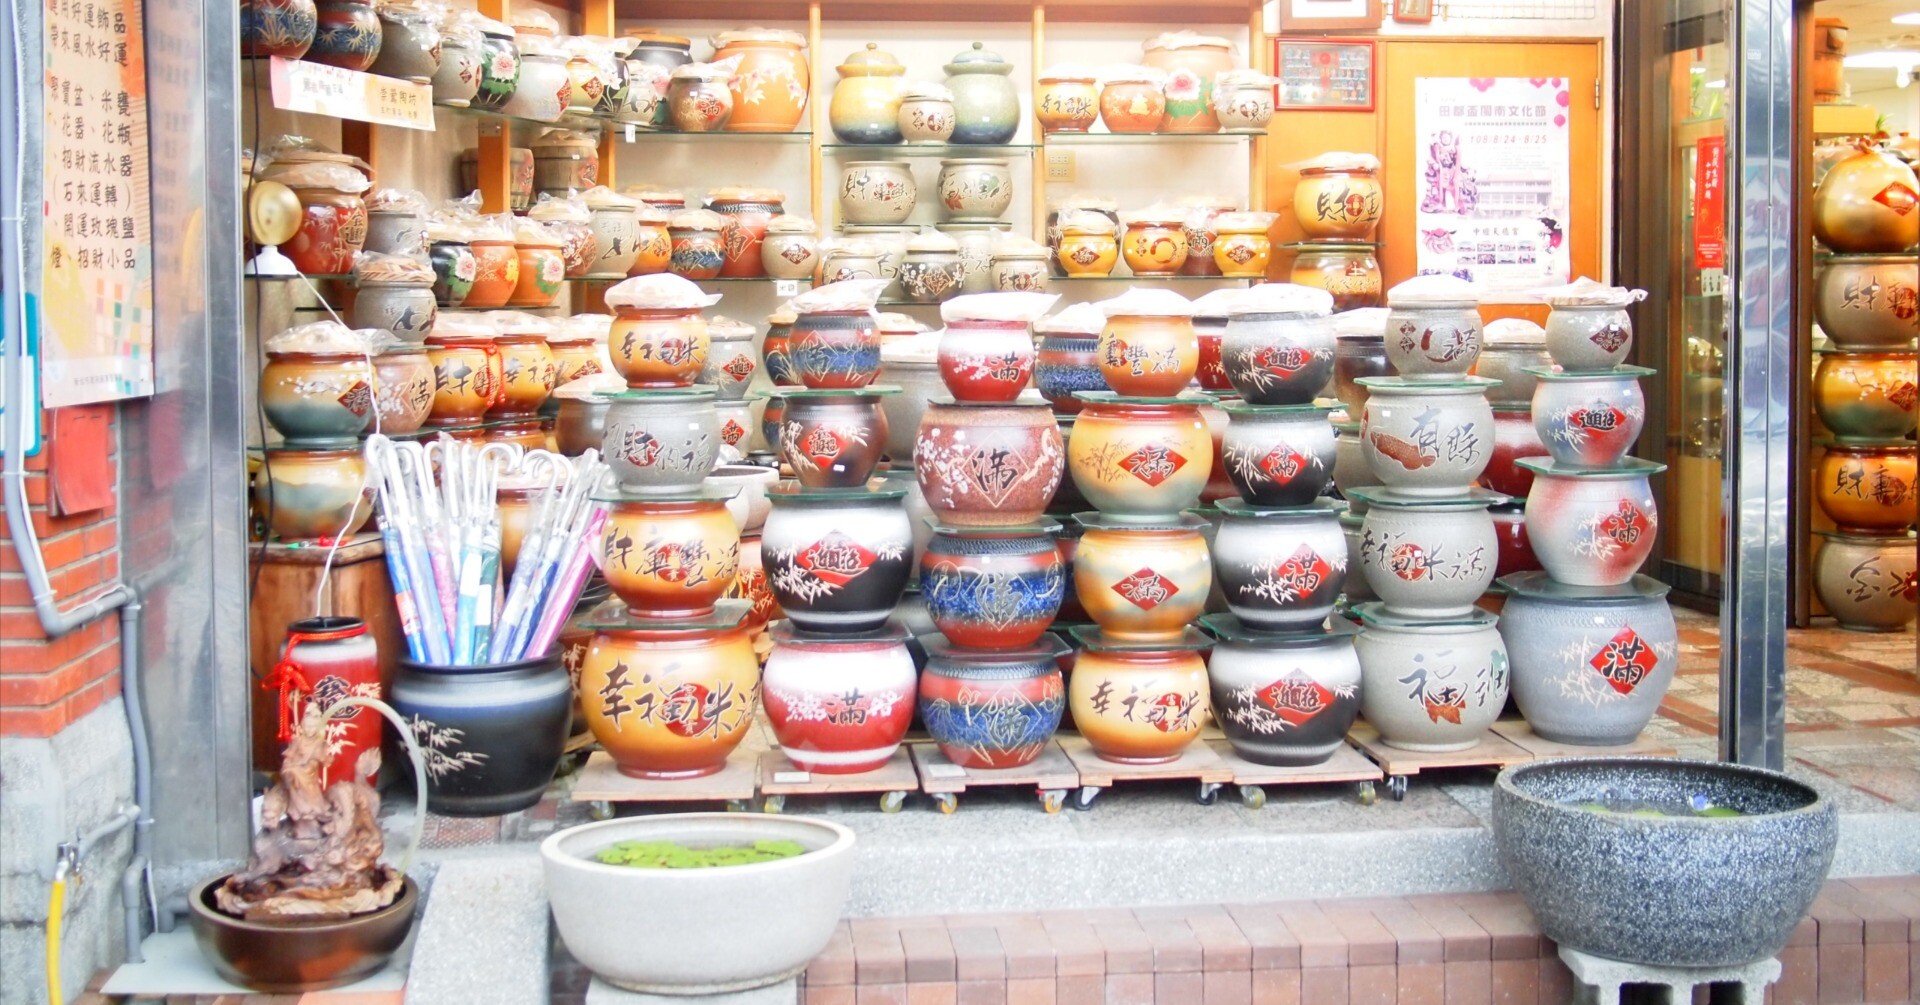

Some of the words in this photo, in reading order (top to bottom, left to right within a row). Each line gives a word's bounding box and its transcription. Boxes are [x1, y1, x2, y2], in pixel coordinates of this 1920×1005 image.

[990, 351, 1019, 382] 滿
[972, 448, 1019, 492] 滿
[1608, 503, 1640, 543] 滿
[1285, 552, 1321, 591] 滿
[1602, 636, 1644, 687] 滿
[827, 687, 867, 726] 滿
